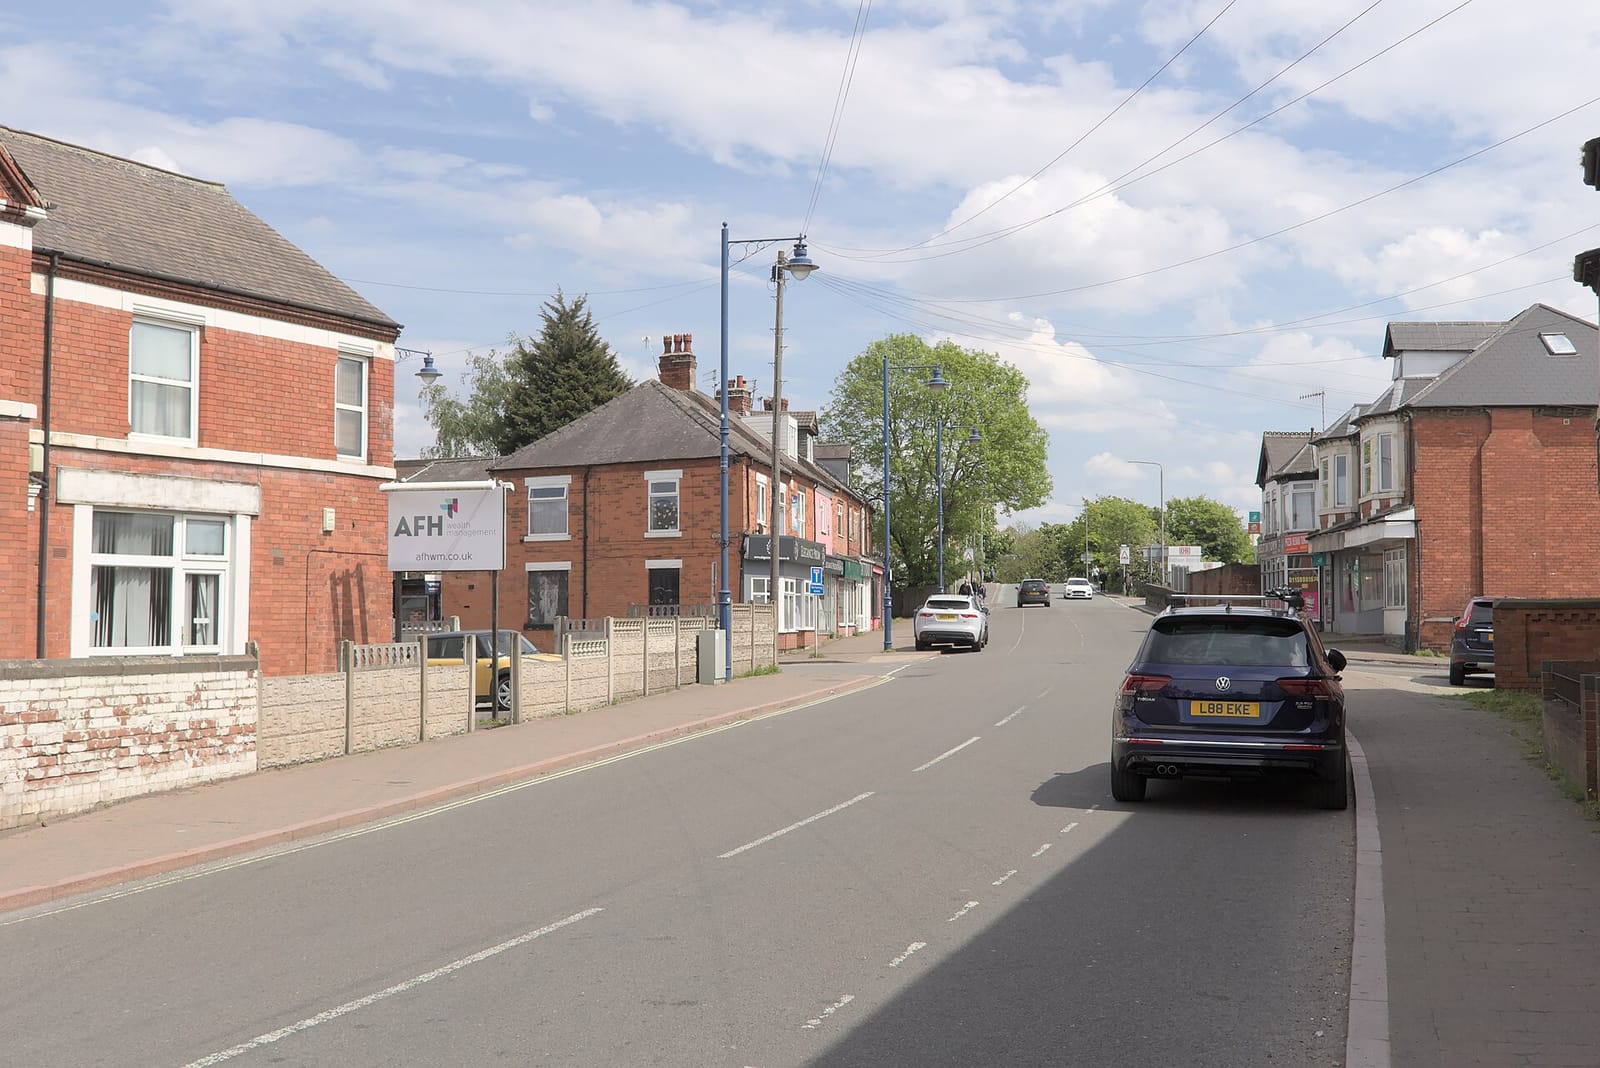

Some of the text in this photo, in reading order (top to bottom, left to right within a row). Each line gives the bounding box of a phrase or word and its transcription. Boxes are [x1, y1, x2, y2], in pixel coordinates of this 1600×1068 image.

[394, 515, 443, 537] AFH
[446, 529, 496, 537] management
[415, 552, 473, 561] afhwm.co.uk
[1200, 703, 1250, 715] L88 EKE
